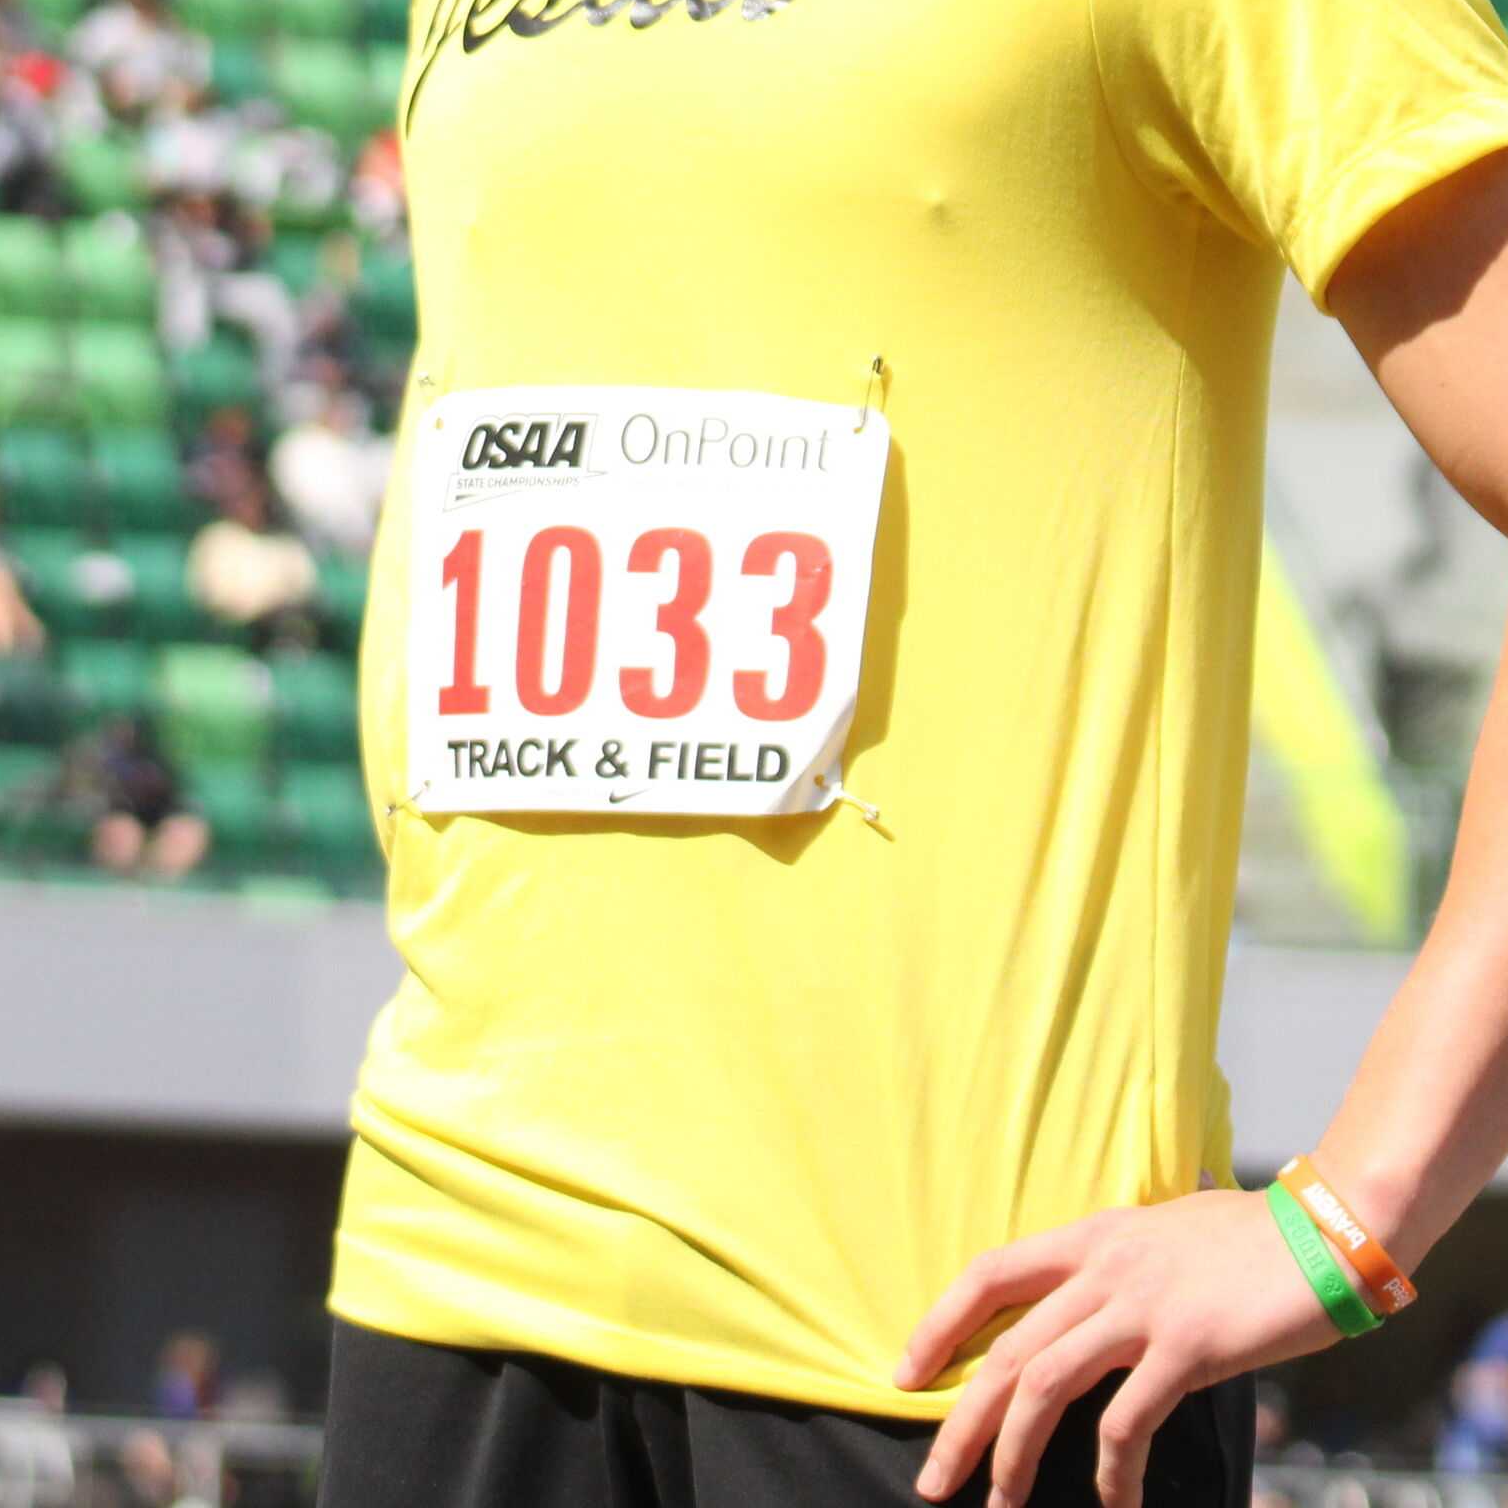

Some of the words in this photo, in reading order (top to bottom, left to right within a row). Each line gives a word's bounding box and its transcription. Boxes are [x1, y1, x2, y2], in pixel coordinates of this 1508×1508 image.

[461, 421, 589, 471] OSAA
[619, 412, 831, 473] OnPoint
[456, 476, 485, 490] STATE
[487, 475, 581, 489] CHAMPIONSHIPS
[437, 524, 835, 723] 1033
[447, 738, 579, 781] TRACK
[593, 738, 630, 780] &
[647, 739, 792, 785] FIELD
